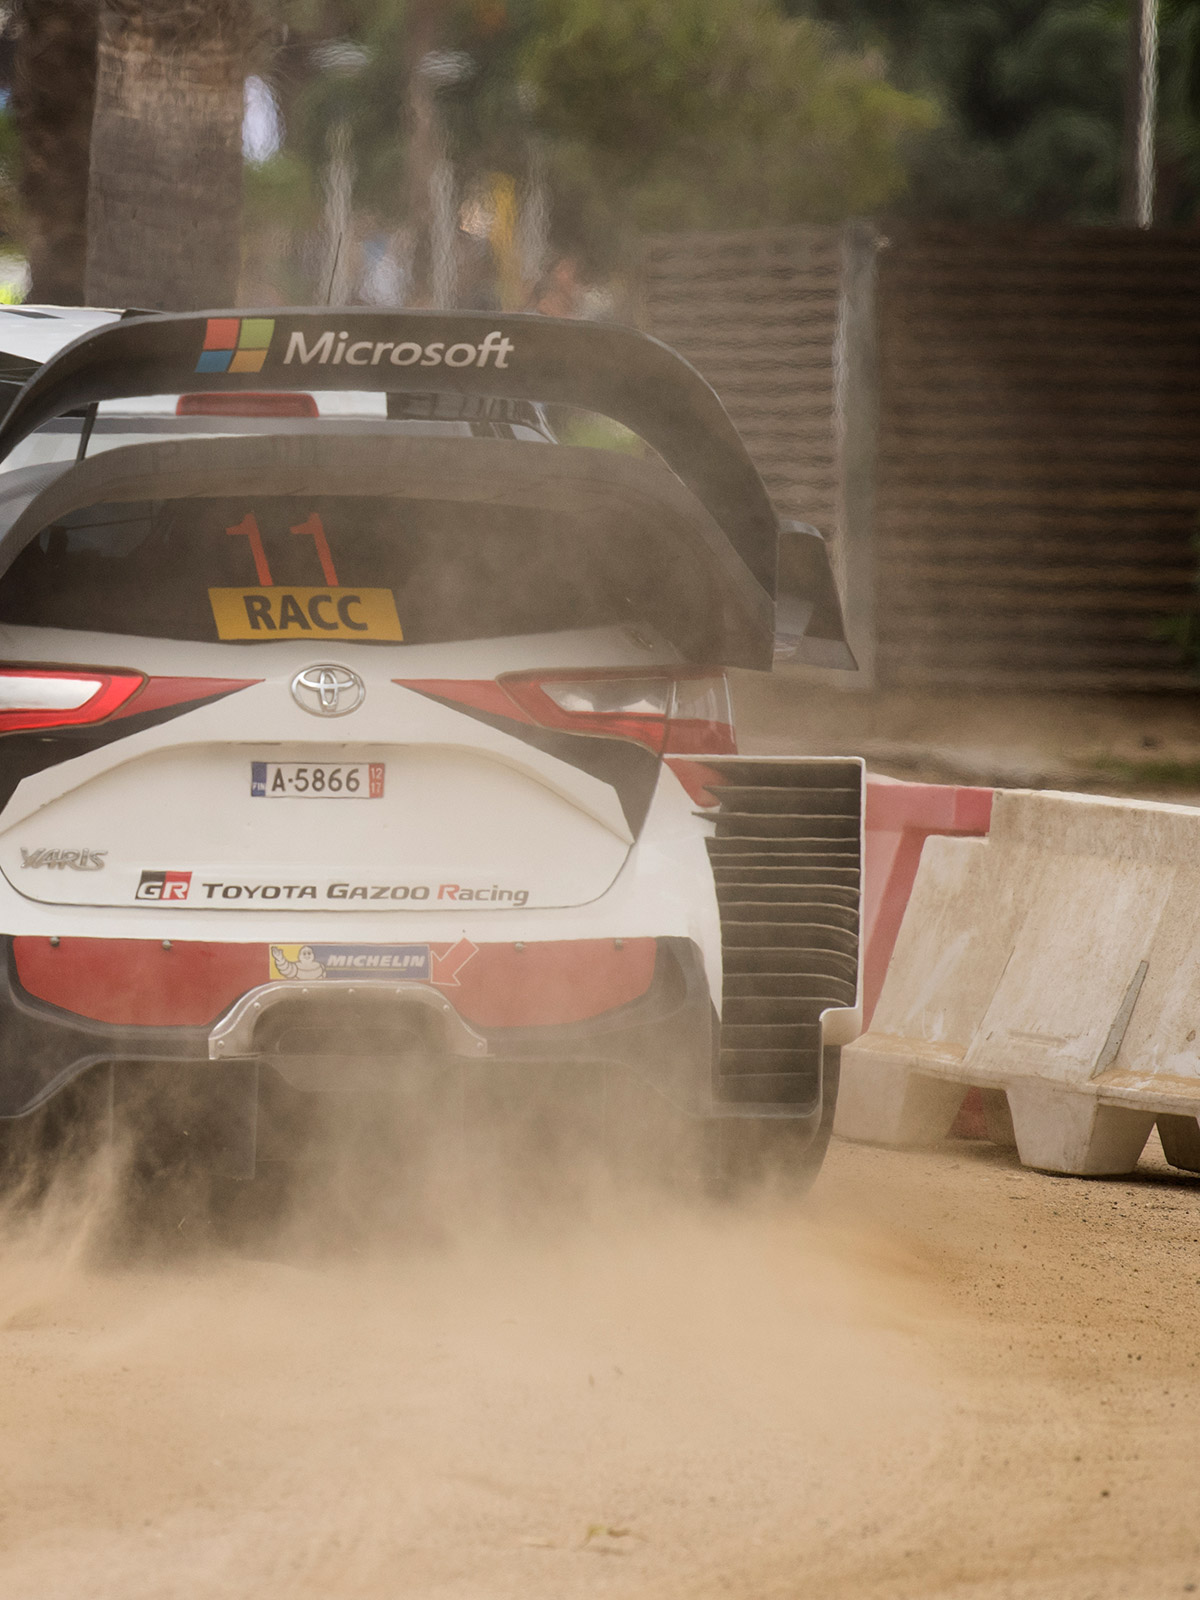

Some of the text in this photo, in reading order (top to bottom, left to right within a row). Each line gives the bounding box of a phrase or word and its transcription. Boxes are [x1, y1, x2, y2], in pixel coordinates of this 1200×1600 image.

[283, 331, 514, 369] Microsoft
[225, 512, 340, 587] 11
[243, 594, 369, 632] RACC
[370, 767, 383, 781] 12
[370, 782, 382, 794] 17
[20, 847, 108, 871] YARIS
[136, 880, 529, 906] GR TOYOTA GAZOO Racing
[327, 954, 426, 968] MICHELIN
